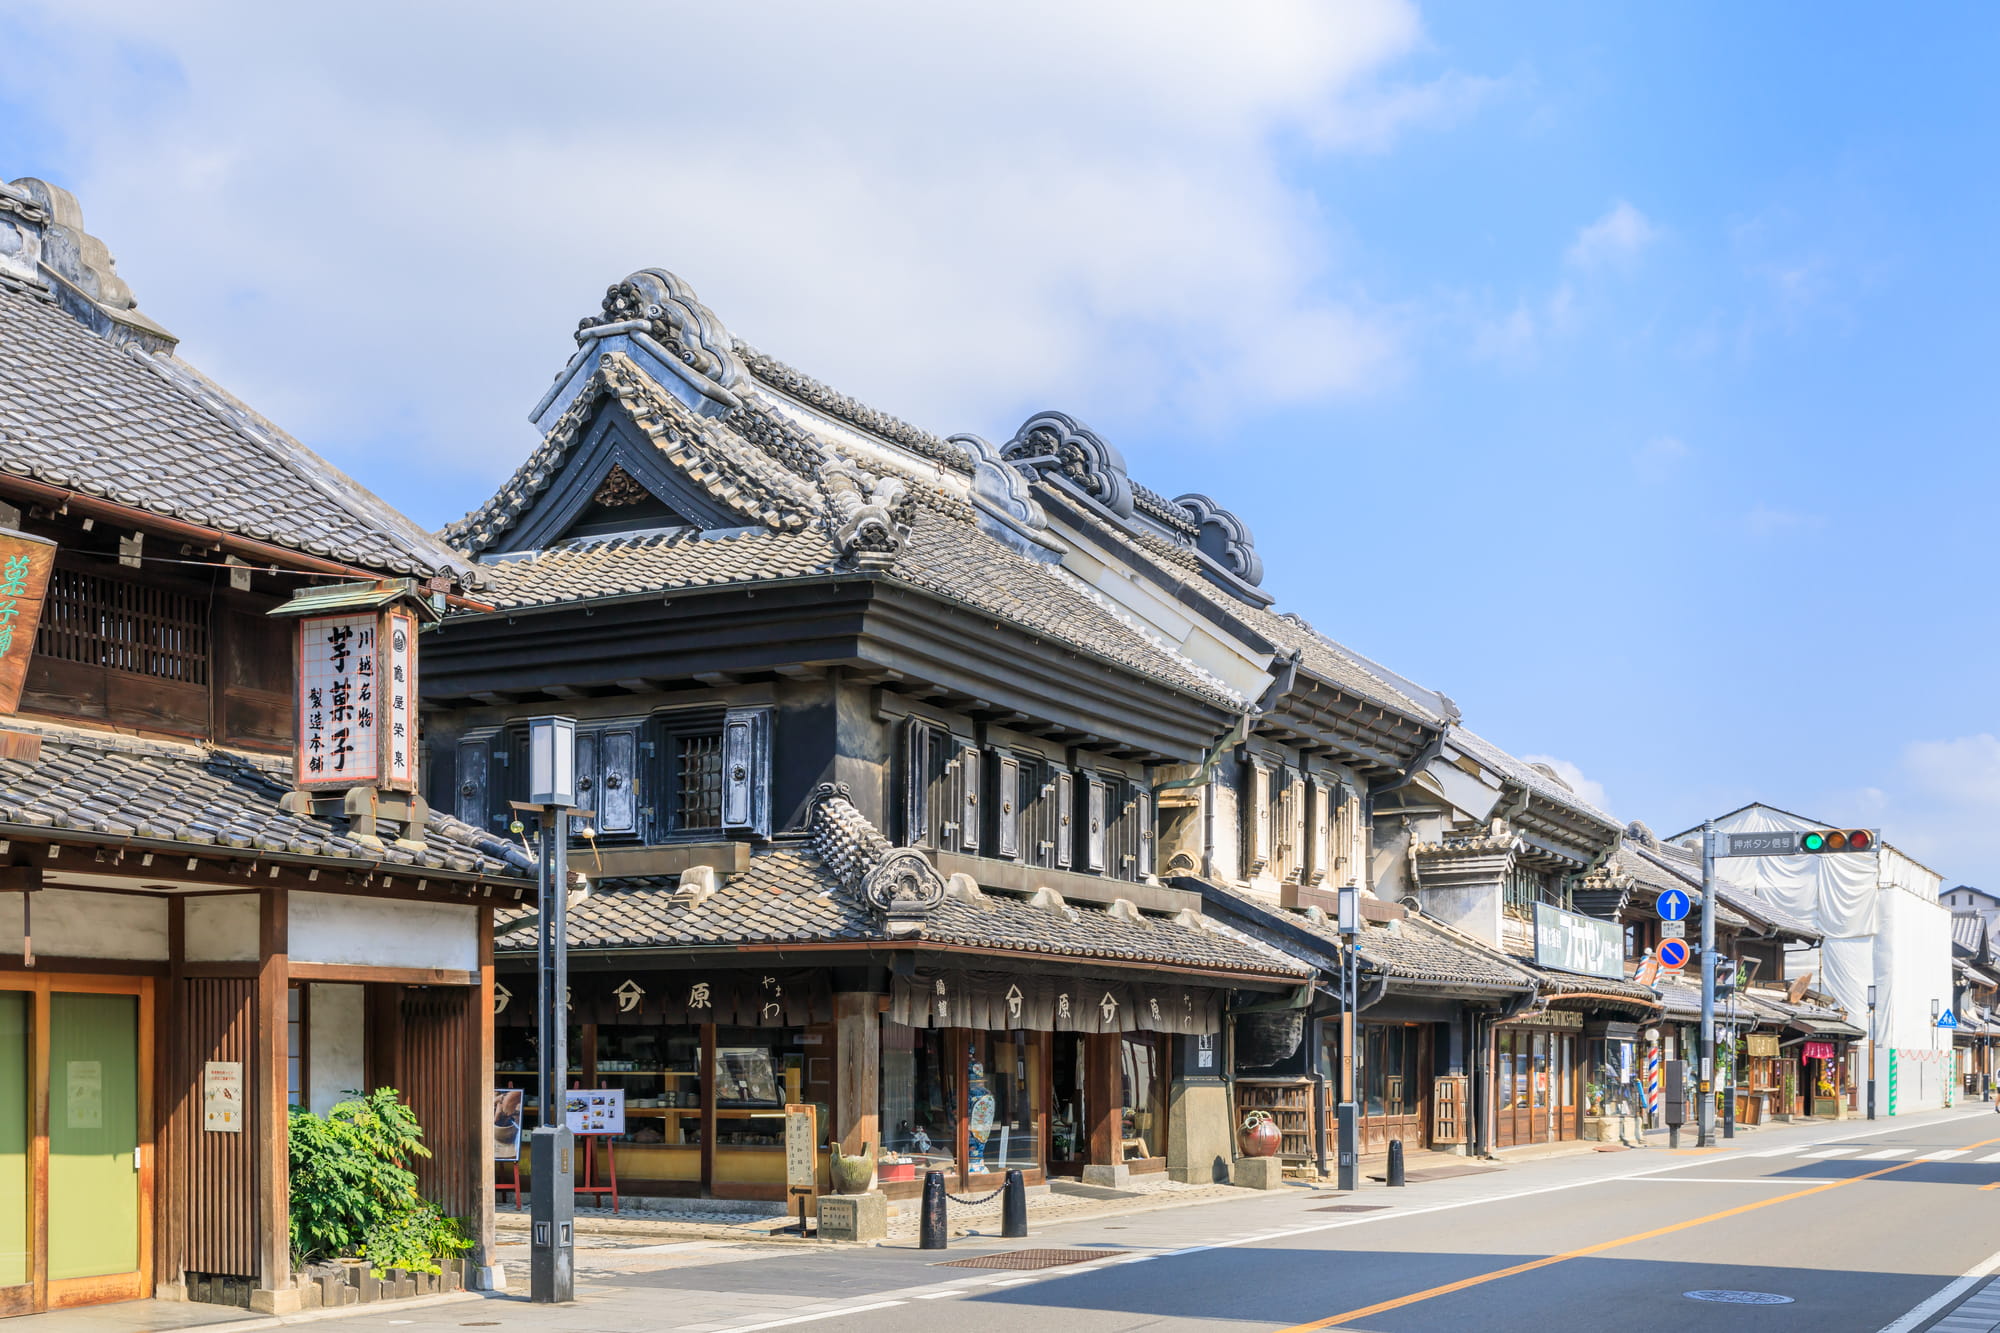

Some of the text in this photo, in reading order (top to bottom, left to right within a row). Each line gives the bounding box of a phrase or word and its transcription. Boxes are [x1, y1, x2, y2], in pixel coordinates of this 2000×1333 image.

[358, 627, 374, 729] 川越名物
[328, 624, 354, 772] 芋菓子
[1734, 838, 1790, 850] 押ボタン信号
[689, 982, 712, 1009] 原
[762, 976, 782, 1020] やまわ
[1058, 993, 1071, 1018] 原
[1150, 998, 1161, 1021] 原
